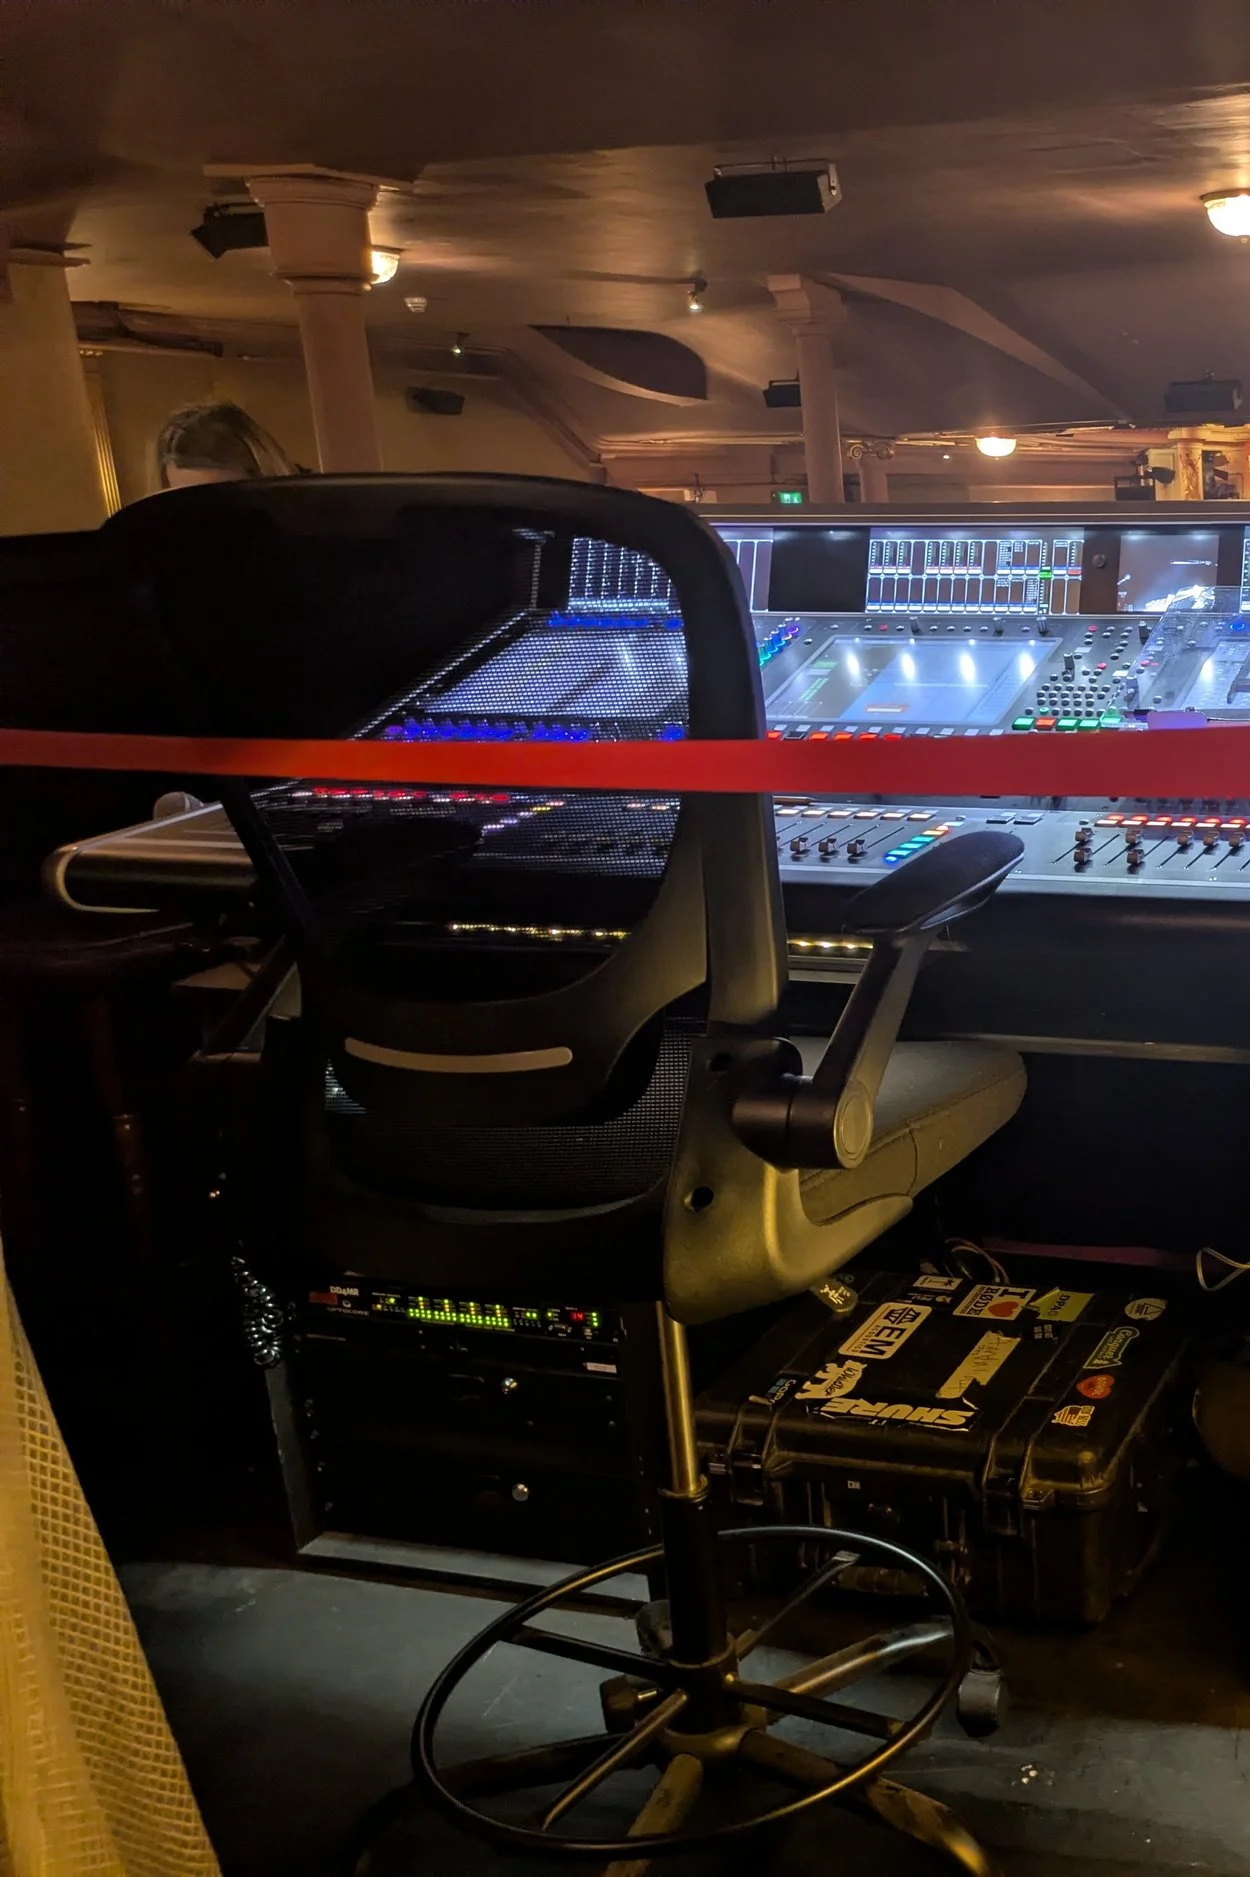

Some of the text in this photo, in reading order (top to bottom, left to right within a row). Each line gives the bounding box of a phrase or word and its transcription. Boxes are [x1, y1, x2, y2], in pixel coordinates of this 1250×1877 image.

[968, 1287, 999, 1316] RØDE
[996, 1288, 1028, 1299] I
[860, 1325, 906, 1356] EM
[820, 1397, 975, 1426] SHURE
